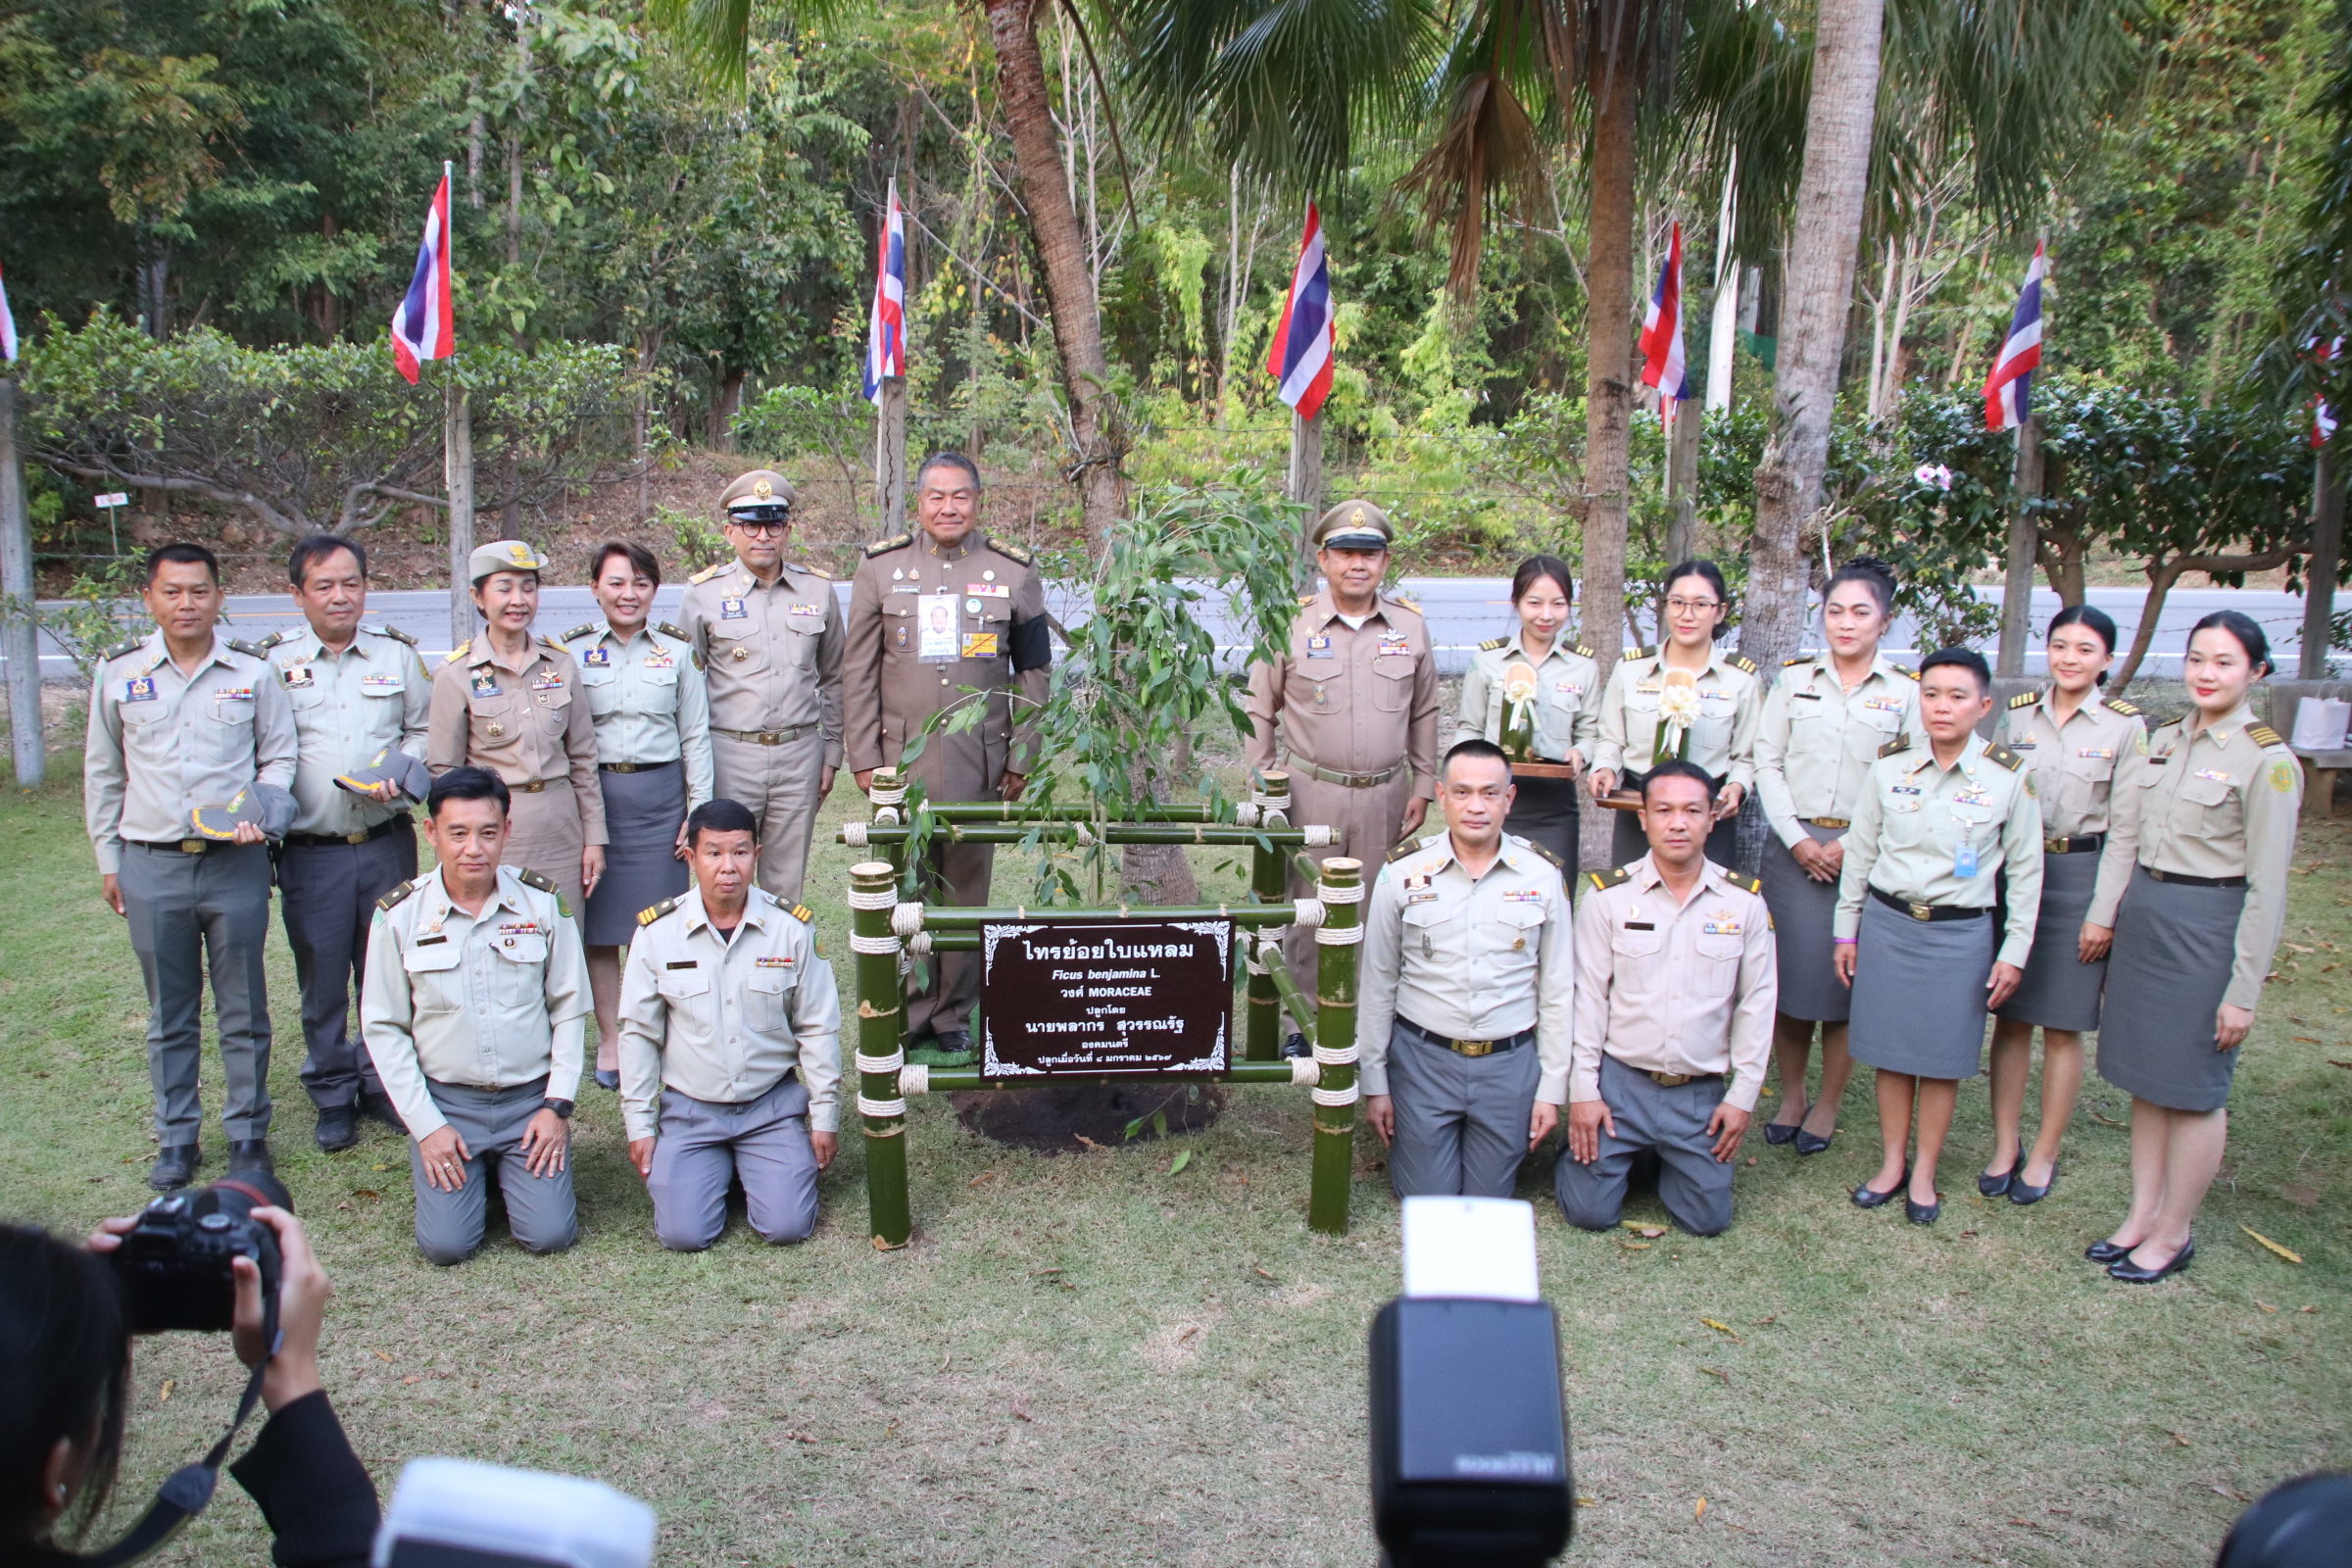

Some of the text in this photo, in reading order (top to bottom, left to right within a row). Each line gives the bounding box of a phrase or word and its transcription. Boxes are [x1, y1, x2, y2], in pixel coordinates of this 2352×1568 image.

[1022, 938, 1194, 960] ไทรย้อยใบแหลม
[1052, 967, 1161, 981] Ficus benjamina L.
[1060, 985, 1152, 998] วงศ์ MORACEAE
[1086, 1004, 1126, 1018] ปลูกโดย
[1025, 1015, 1185, 1037] นายพลากร สุวรรณรัฐ
[1081, 1038, 1129, 1050] องคมนตรี
[1037, 1051, 1093, 1067] ปลูกเมื่อวันที่
[1104, 1054, 1143, 1062] มกราคม
